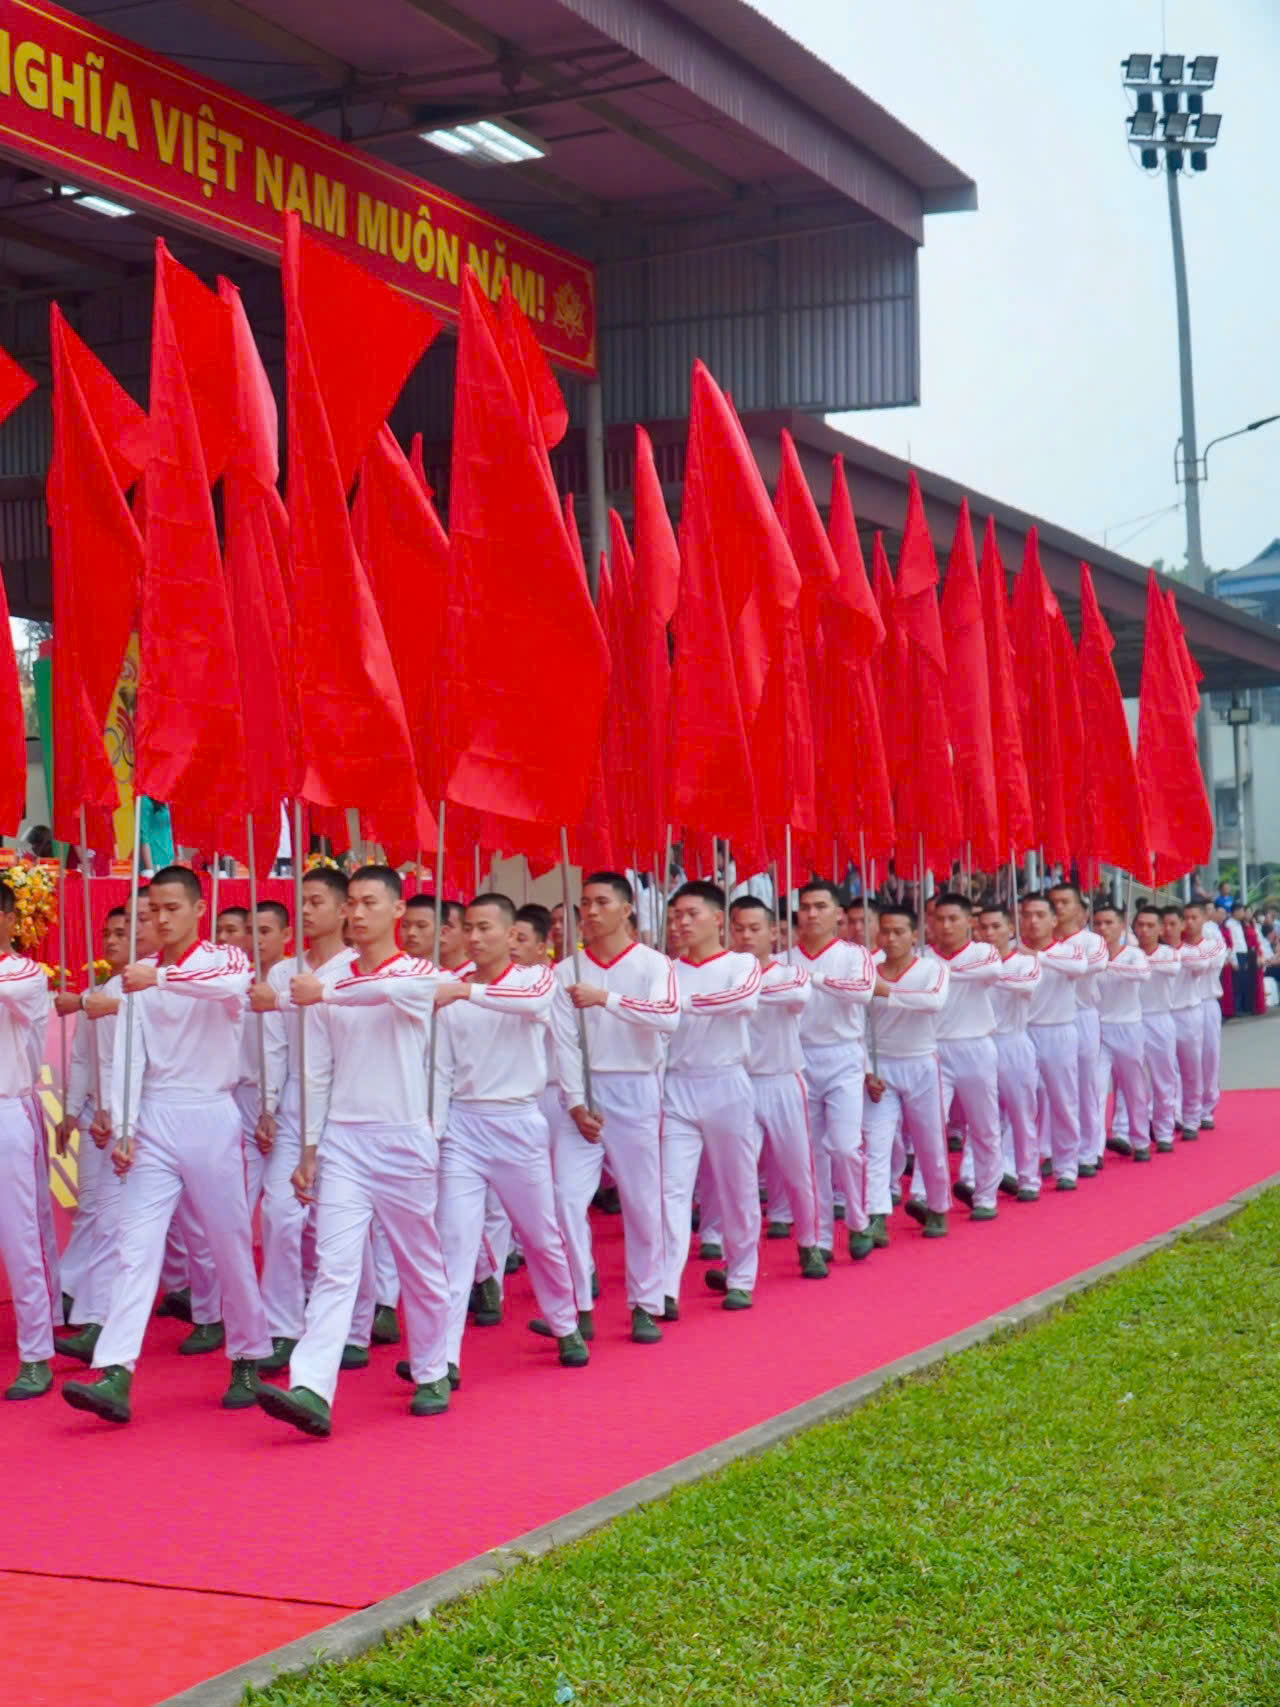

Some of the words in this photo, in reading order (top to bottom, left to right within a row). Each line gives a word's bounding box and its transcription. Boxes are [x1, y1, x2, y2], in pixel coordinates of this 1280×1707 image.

[151, 99, 243, 197] VIỆT
[255, 147, 346, 238] NAM
[358, 194, 458, 286] MUÔN
